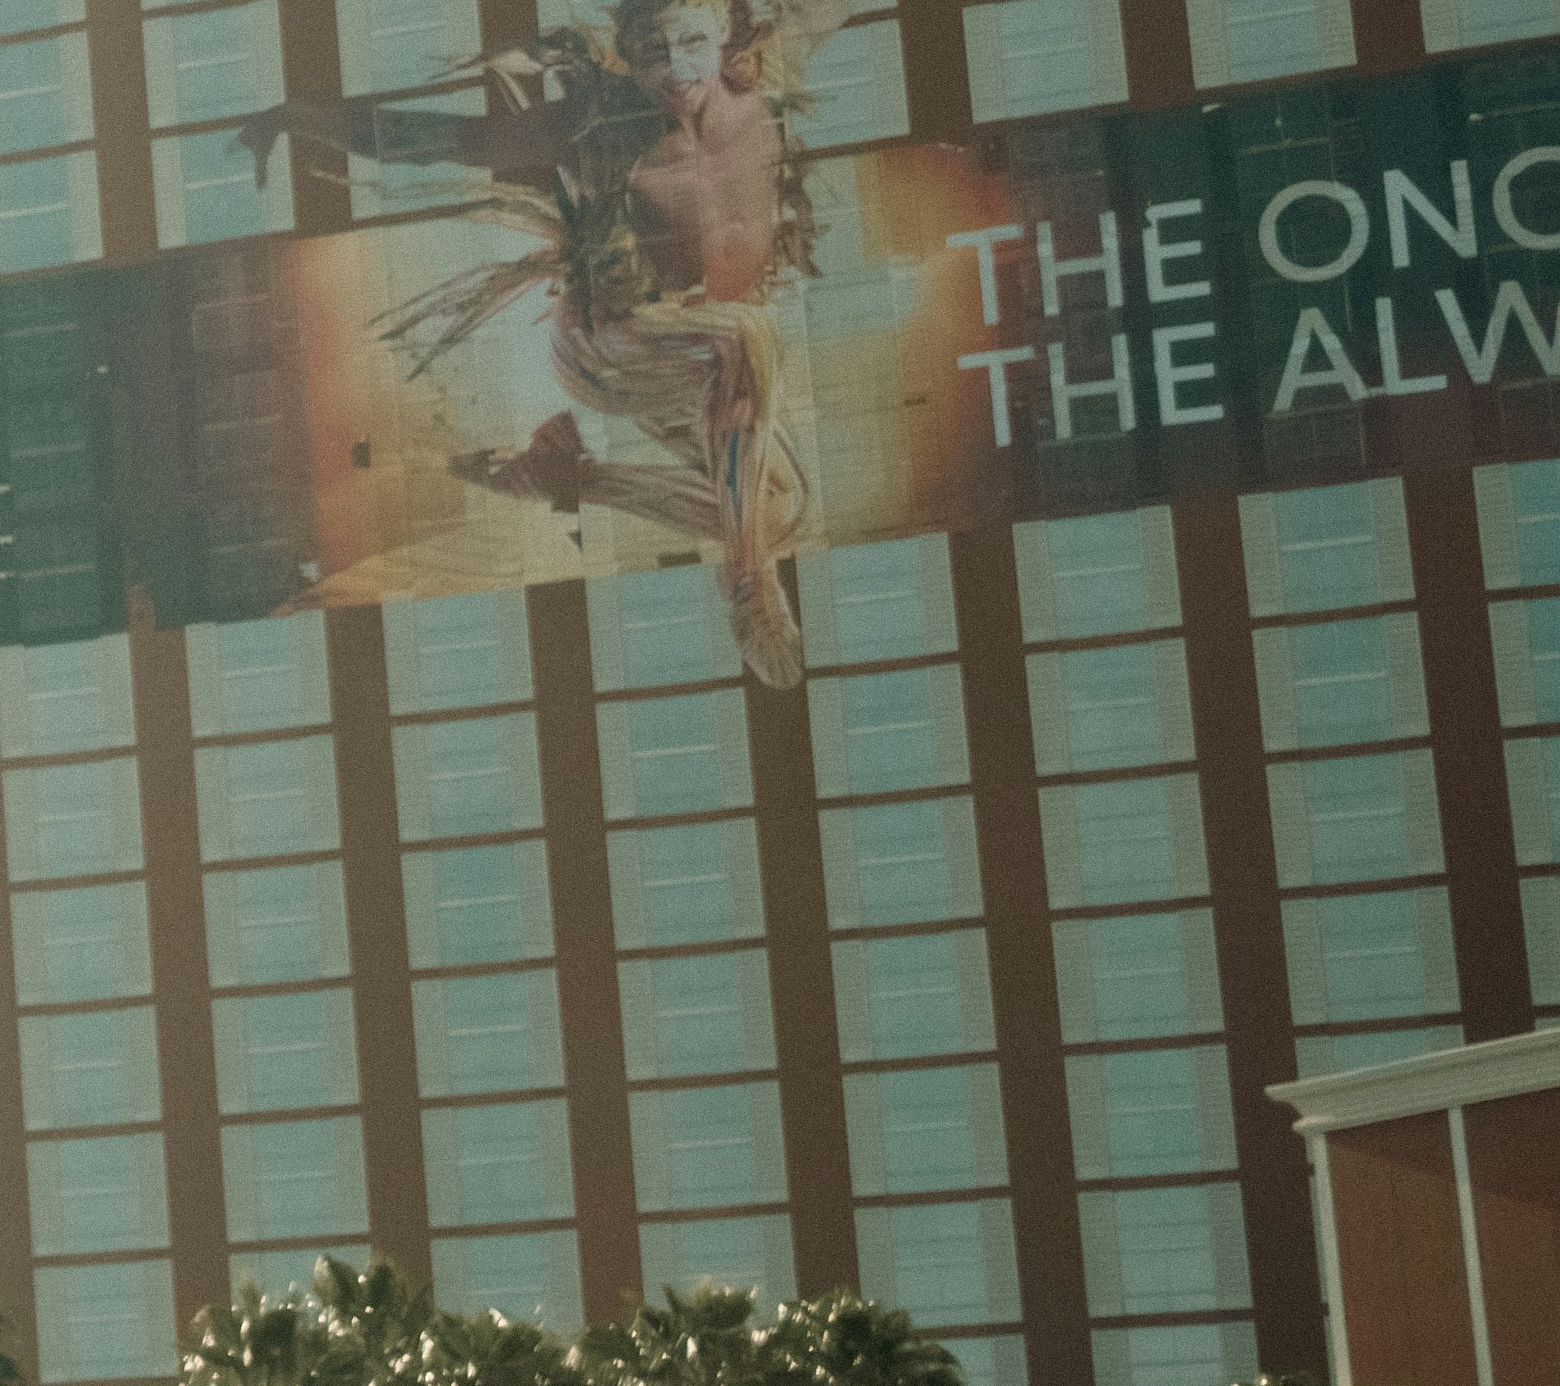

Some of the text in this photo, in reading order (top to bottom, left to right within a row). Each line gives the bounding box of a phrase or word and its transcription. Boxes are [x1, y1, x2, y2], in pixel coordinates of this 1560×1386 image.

[946, 199, 1212, 327] THE
[957, 280, 1560, 448] THE ALW
